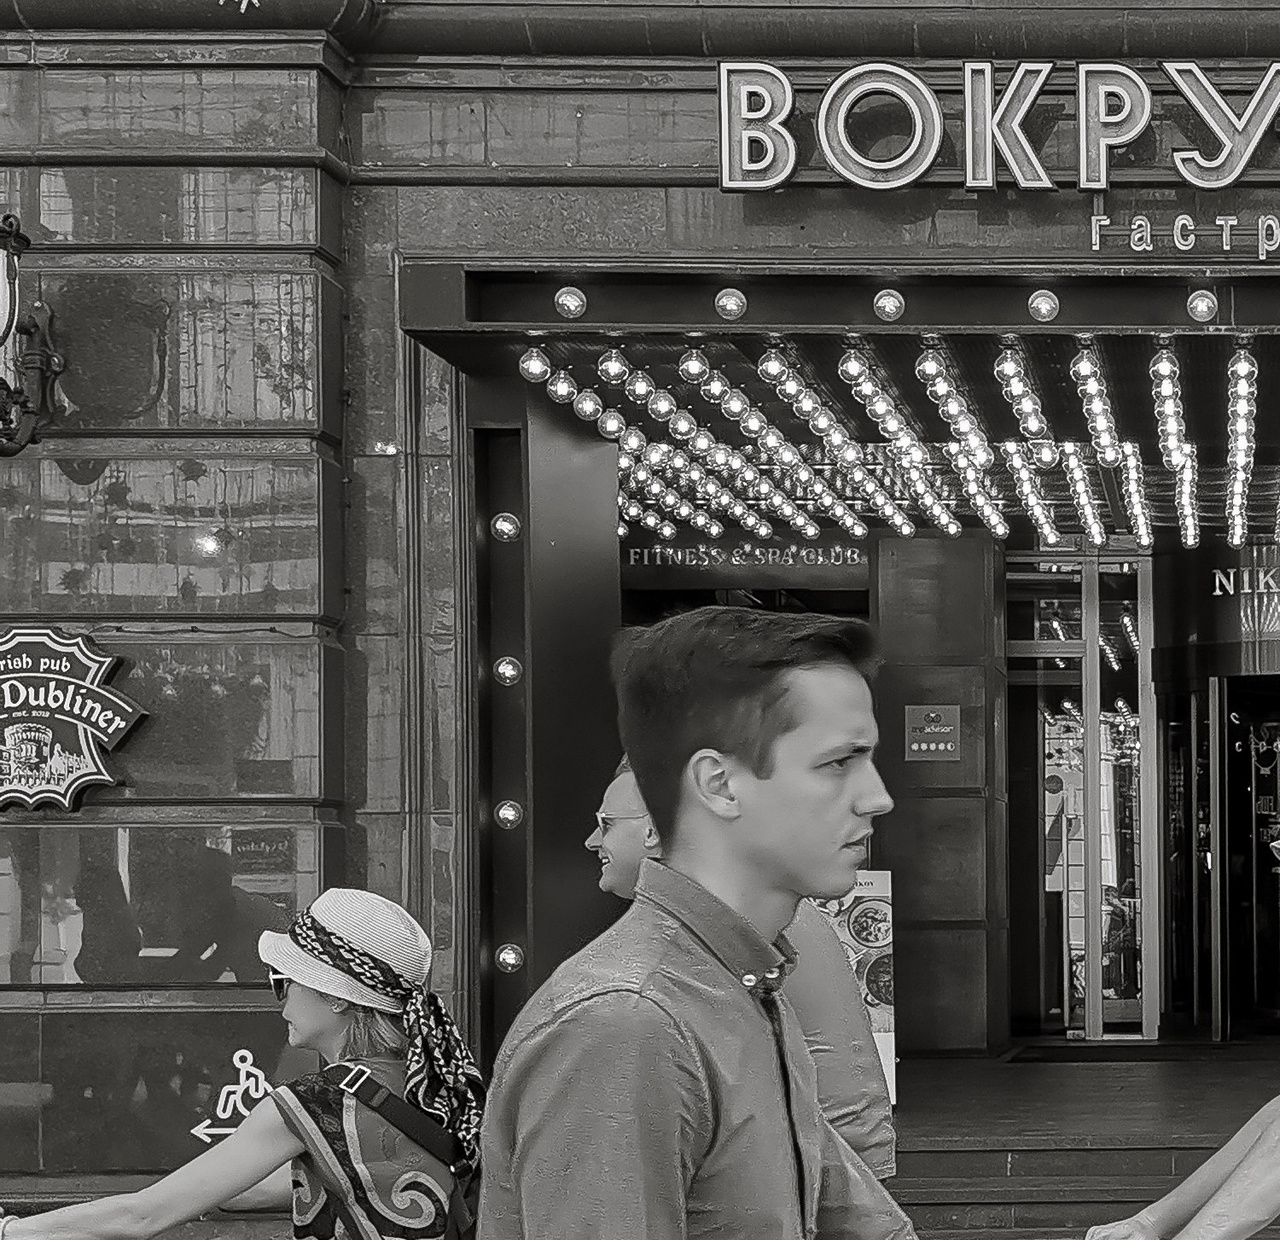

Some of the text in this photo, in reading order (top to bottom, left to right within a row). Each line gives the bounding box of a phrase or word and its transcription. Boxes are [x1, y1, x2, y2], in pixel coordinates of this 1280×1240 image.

[629, 548, 724, 566] FITNESS
[754, 548, 793, 566] SPA
[803, 548, 861, 566] CLUB
[40, 657, 71, 673] pub
[1, 679, 127, 734] Dubliner
